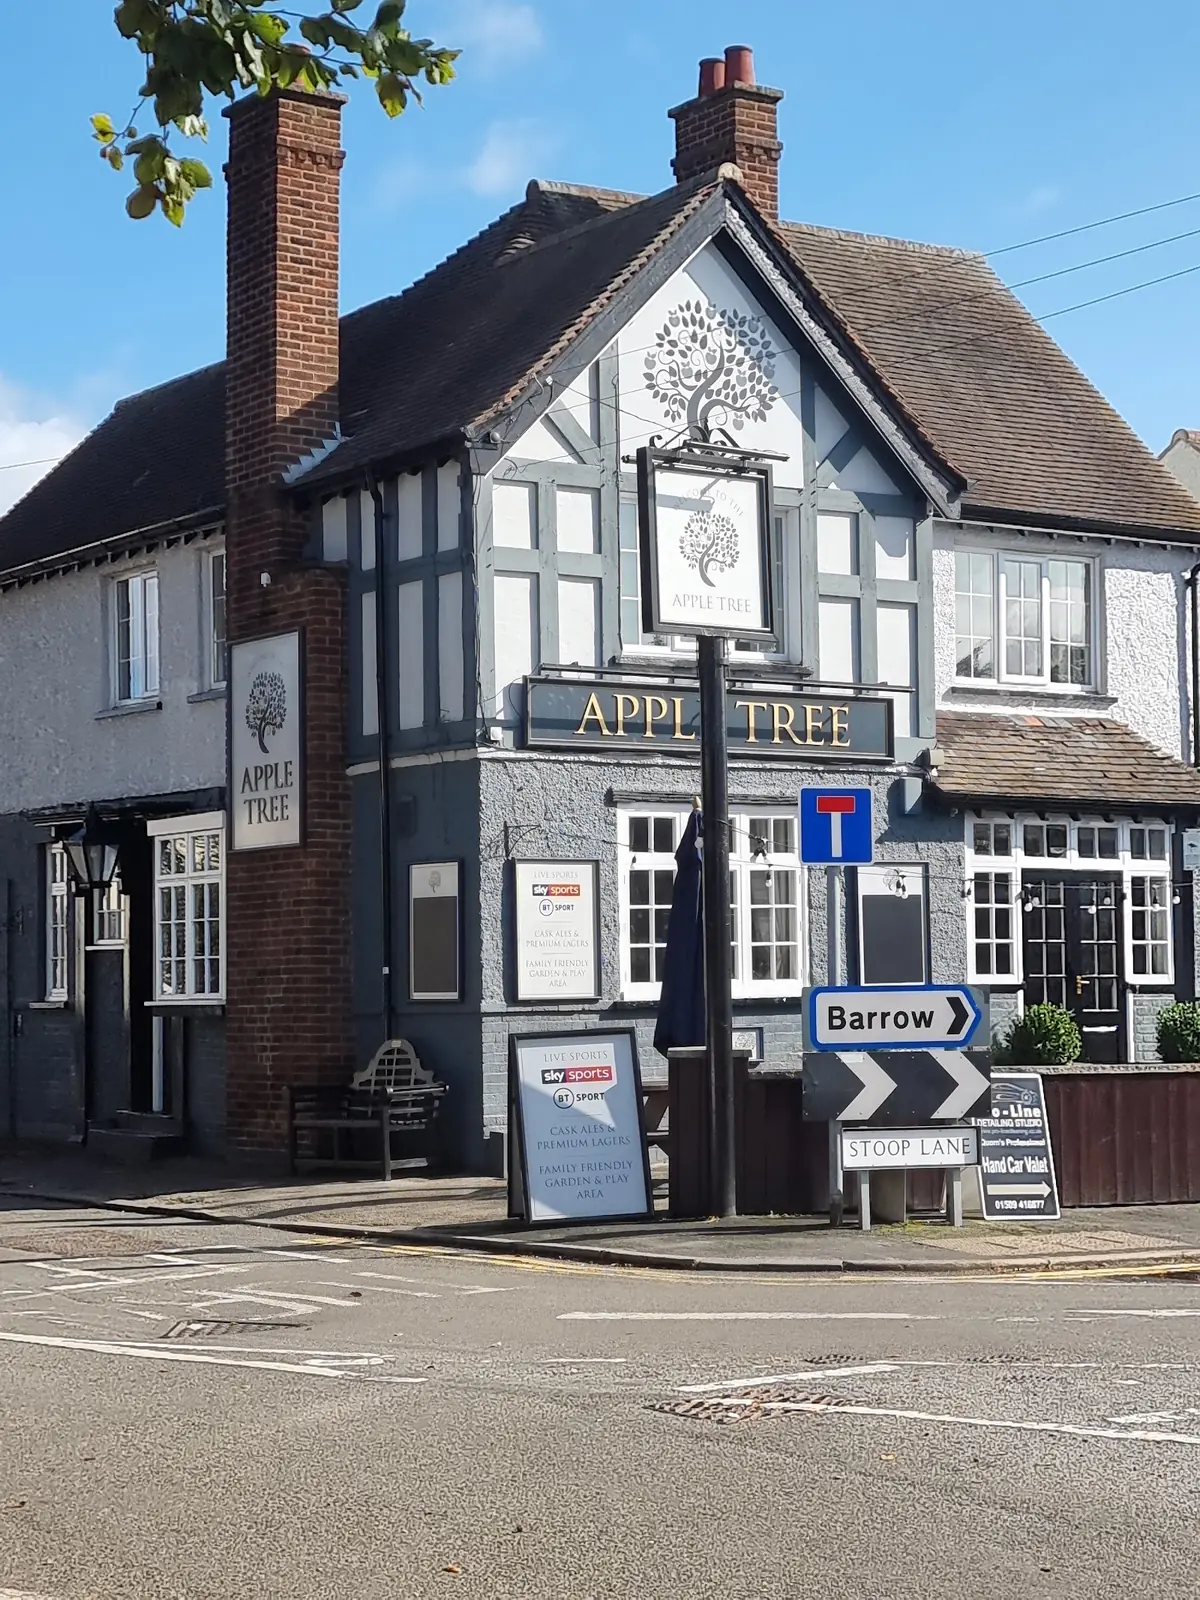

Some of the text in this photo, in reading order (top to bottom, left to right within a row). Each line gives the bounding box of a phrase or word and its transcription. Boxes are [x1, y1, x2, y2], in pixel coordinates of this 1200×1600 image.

[672, 593, 752, 613] APPLE TREE
[573, 692, 851, 747] APPL TREE
[240, 760, 293, 794] APPLE
[243, 794, 289, 825] TREE
[534, 871, 579, 879] LIVE SPORTS
[533, 884, 579, 896] sky sports
[534, 930, 554, 938] CASK
[555, 930, 572, 938] ALES
[526, 940, 589, 948] PREMIUM LAGERS
[525, 960, 589, 968] FAMILY FRIENDLY
[529, 970, 586, 978] GARDEN & PLAY
[828, 1006, 935, 1031] Barrow
[544, 1050, 608, 1063] LIVE SPORTS
[544, 1067, 610, 1083] sky sports
[558, 1092, 605, 1103] BT SPORT
[1015, 1118, 1042, 1127] STUDIO
[549, 1124, 616, 1136] CASK ALES &
[537, 1136, 631, 1150] PREMIUM LAGERS
[849, 1138, 971, 1157] STOOP LANE
[539, 1160, 633, 1175] FAMILY FRIENDLY
[982, 1155, 1049, 1173] Hand Car Valet
[544, 1173, 629, 1188] GARDEN & PLAY
[576, 1189, 604, 1200] AREA
